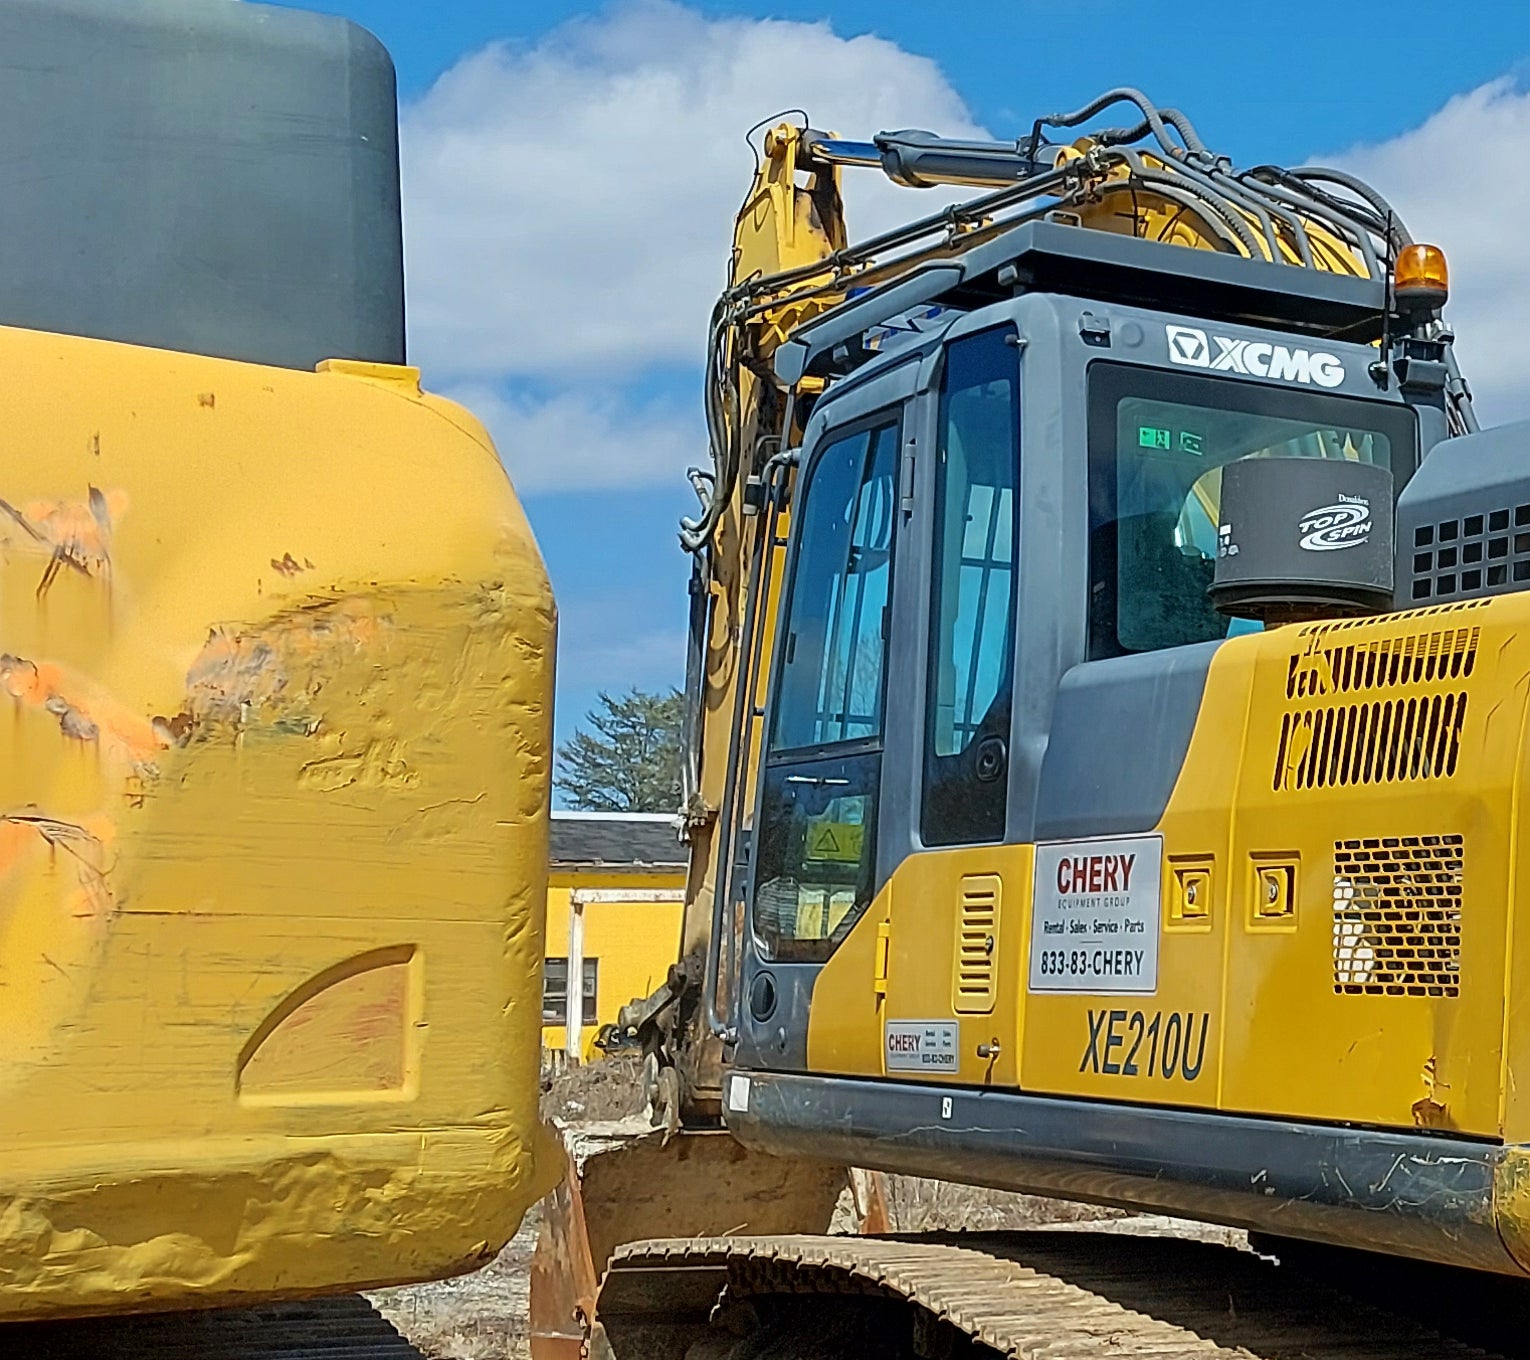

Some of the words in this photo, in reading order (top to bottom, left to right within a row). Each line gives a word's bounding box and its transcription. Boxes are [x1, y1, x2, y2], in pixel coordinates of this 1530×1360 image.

[1209, 336, 1345, 388] XCMG
[1299, 513, 1348, 533] TOP
[1327, 521, 1372, 541] SPIN
[1057, 853, 1136, 894] CHERY
[1058, 897, 1101, 909] EQUIPMENT
[1104, 897, 1130, 908] GROUP
[1044, 920, 1064, 934] Rental
[1070, 919, 1087, 933] Sales
[1093, 918, 1118, 933] Service
[1125, 918, 1144, 933] Parts
[1041, 950, 1144, 975] 833-83-CHERY
[889, 1034, 921, 1051] CHERY
[1079, 1010, 1209, 1081] XE210U
